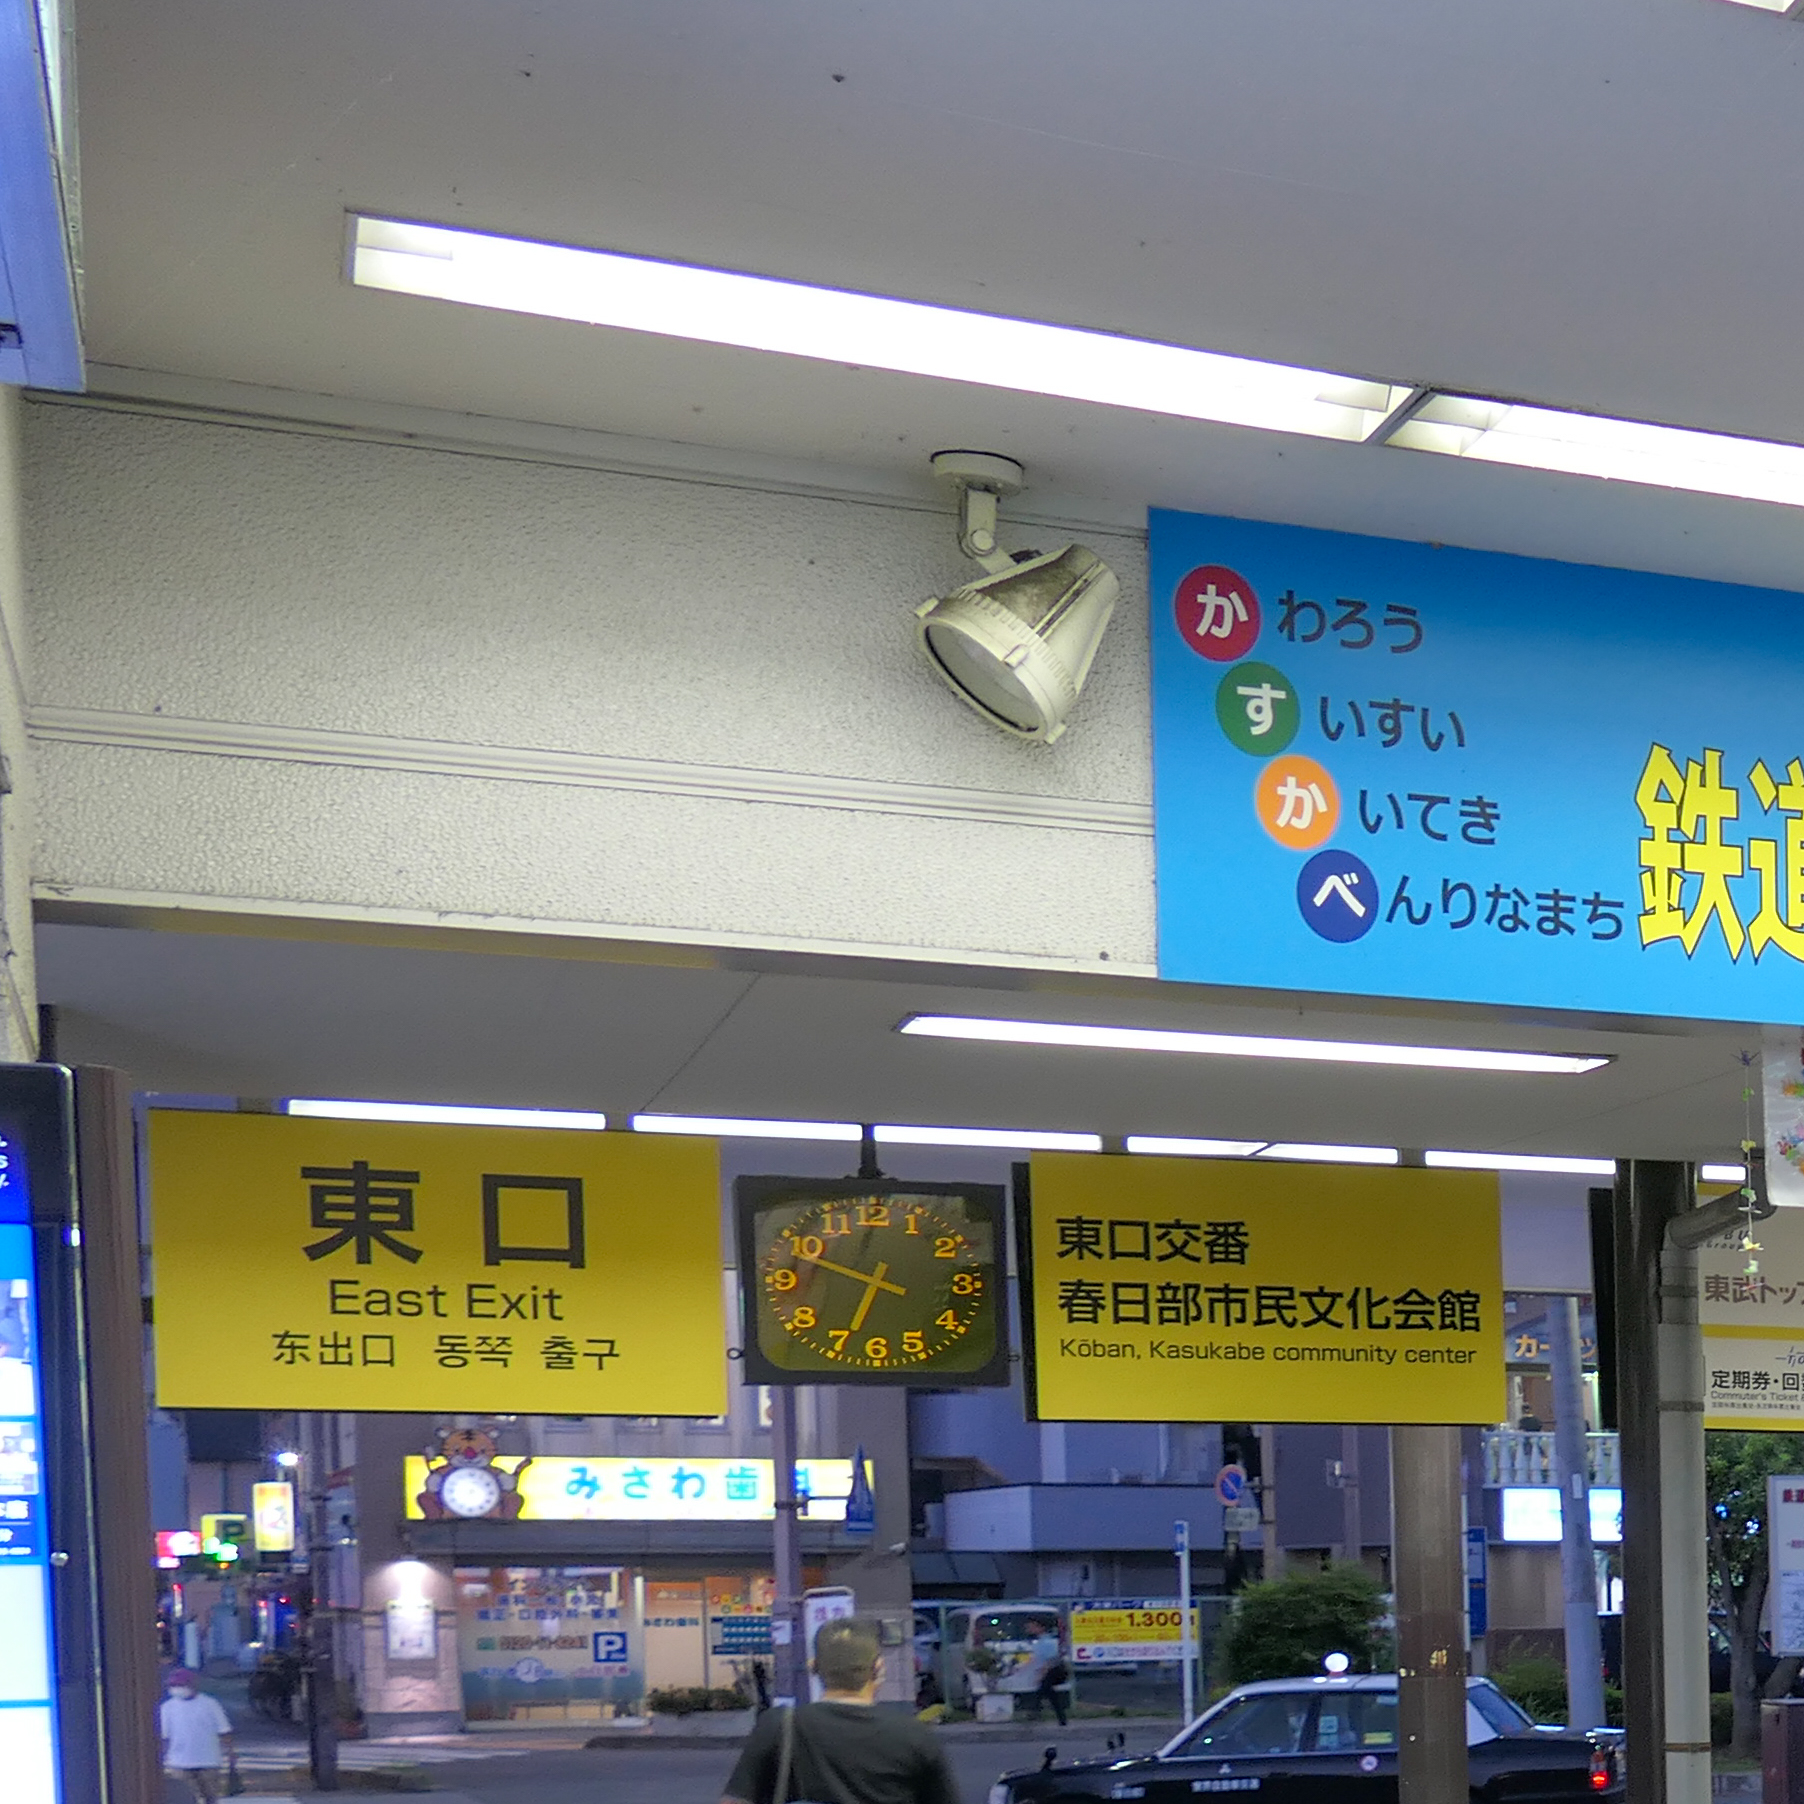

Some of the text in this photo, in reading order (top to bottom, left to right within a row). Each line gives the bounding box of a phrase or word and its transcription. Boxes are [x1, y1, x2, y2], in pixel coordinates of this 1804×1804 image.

[1195, 585, 1425, 655] か わろう
[1234, 683, 1467, 754] す いすい
[1274, 780, 1503, 847] か いてき
[1312, 873, 1625, 942] べ んりなまち
[301, 1160, 587, 1269] 東口
[822, 1213, 851, 1234] 11
[856, 1206, 890, 1227] 12
[905, 1214, 918, 1235] 1
[790, 1236, 824, 1258] 10
[934, 1237, 957, 1258] 2
[1056, 1215, 1250, 1267] 東口交番
[774, 1269, 797, 1291] 9
[952, 1273, 974, 1295] 3
[328, 1279, 565, 1322] East Exit
[1058, 1279, 1483, 1333] 春日部市民文化会館
[792, 1306, 816, 1329] 8
[935, 1309, 958, 1330] 4
[272, 1330, 621, 1372] 东出口 동쪽 출구
[828, 1330, 850, 1351] 7
[865, 1337, 887, 1359] 6
[902, 1331, 925, 1353] 5
[1059, 1338, 1478, 1369] Kōban, Kasukabe community center
